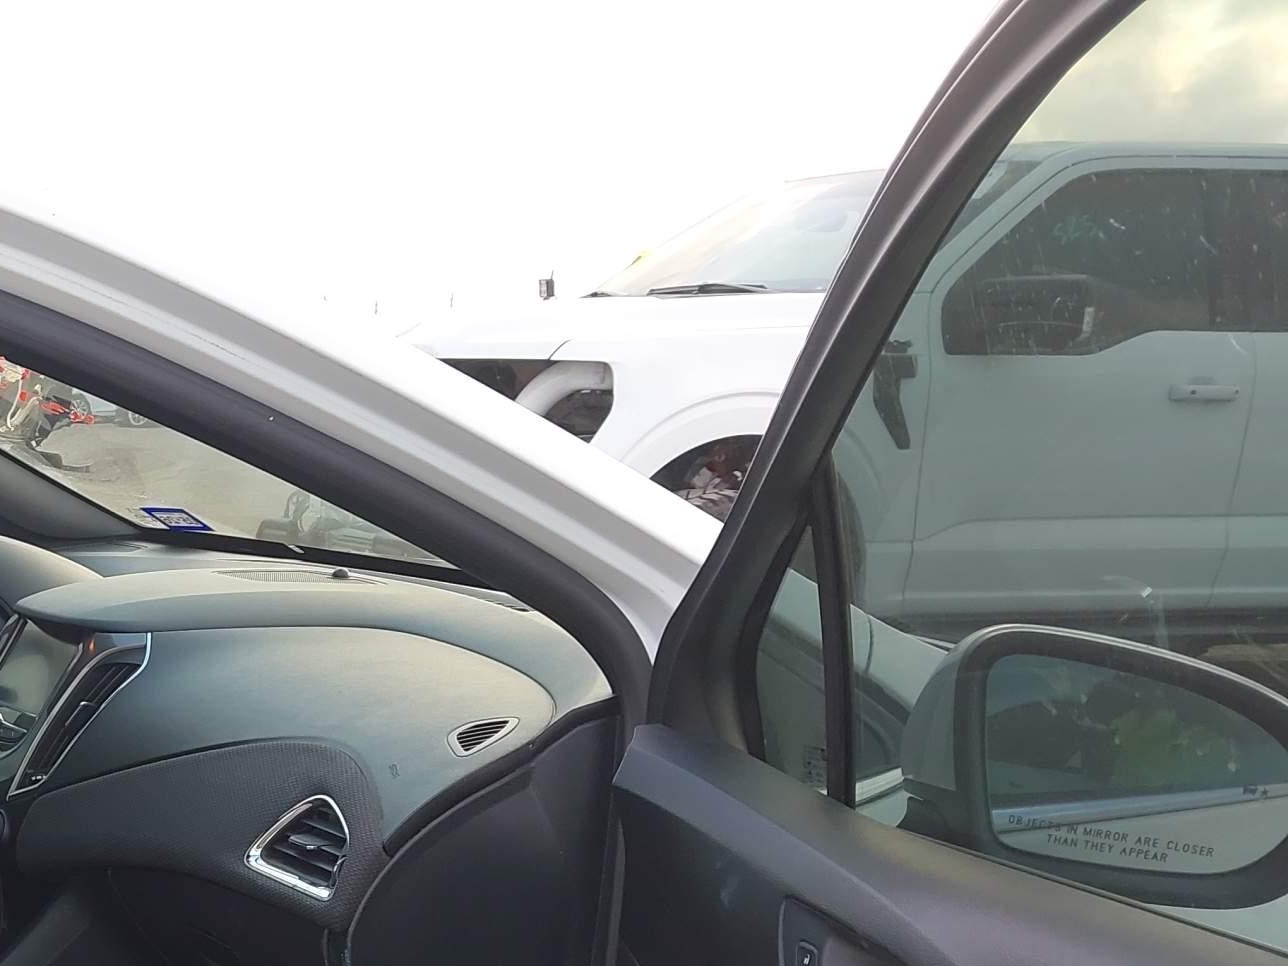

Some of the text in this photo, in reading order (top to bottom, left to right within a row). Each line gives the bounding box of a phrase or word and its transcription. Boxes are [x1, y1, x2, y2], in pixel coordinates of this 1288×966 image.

[1008, 814, 1215, 857] OBJECTS IN MIRROR ARE CLOSER
[1046, 833, 1168, 863] THAN THEY APPEAR
